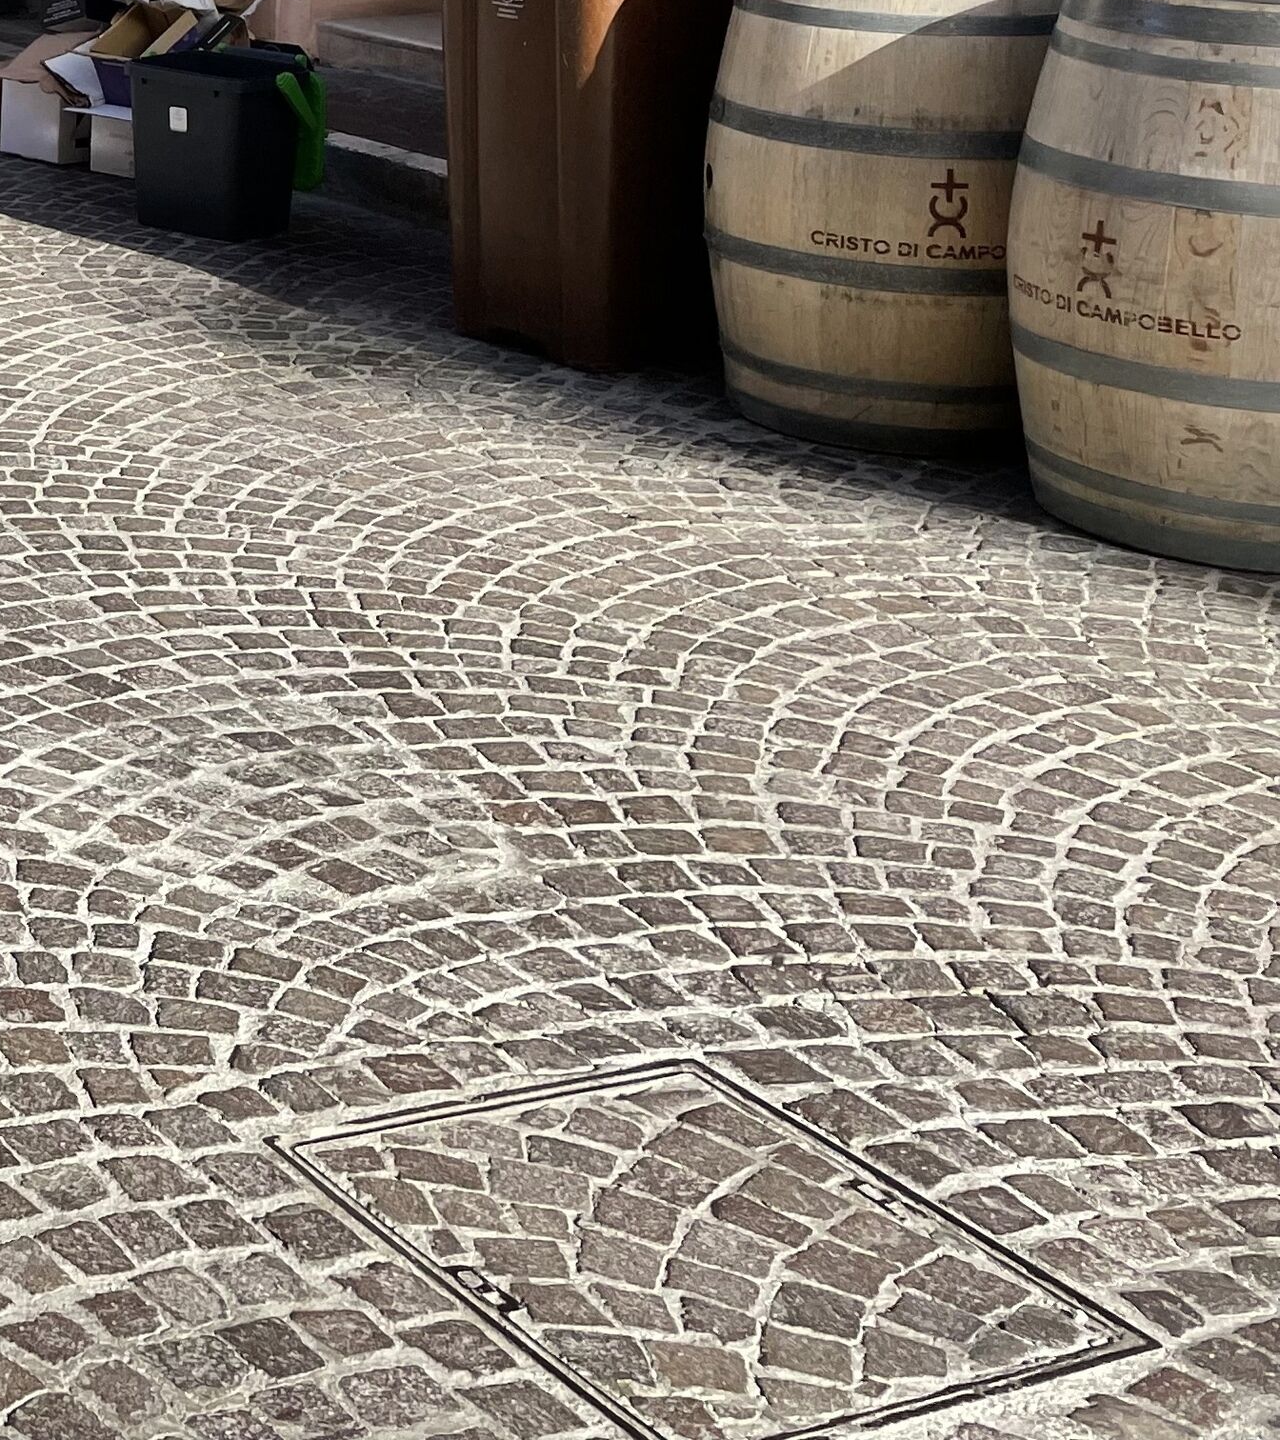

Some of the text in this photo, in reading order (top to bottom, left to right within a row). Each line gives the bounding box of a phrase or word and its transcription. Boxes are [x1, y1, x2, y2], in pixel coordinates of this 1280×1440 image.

[810, 230, 1007, 261] CRISTO DI CAMPO
[1013, 274, 1243, 342] CRISTO DI CAMPOBELLO
